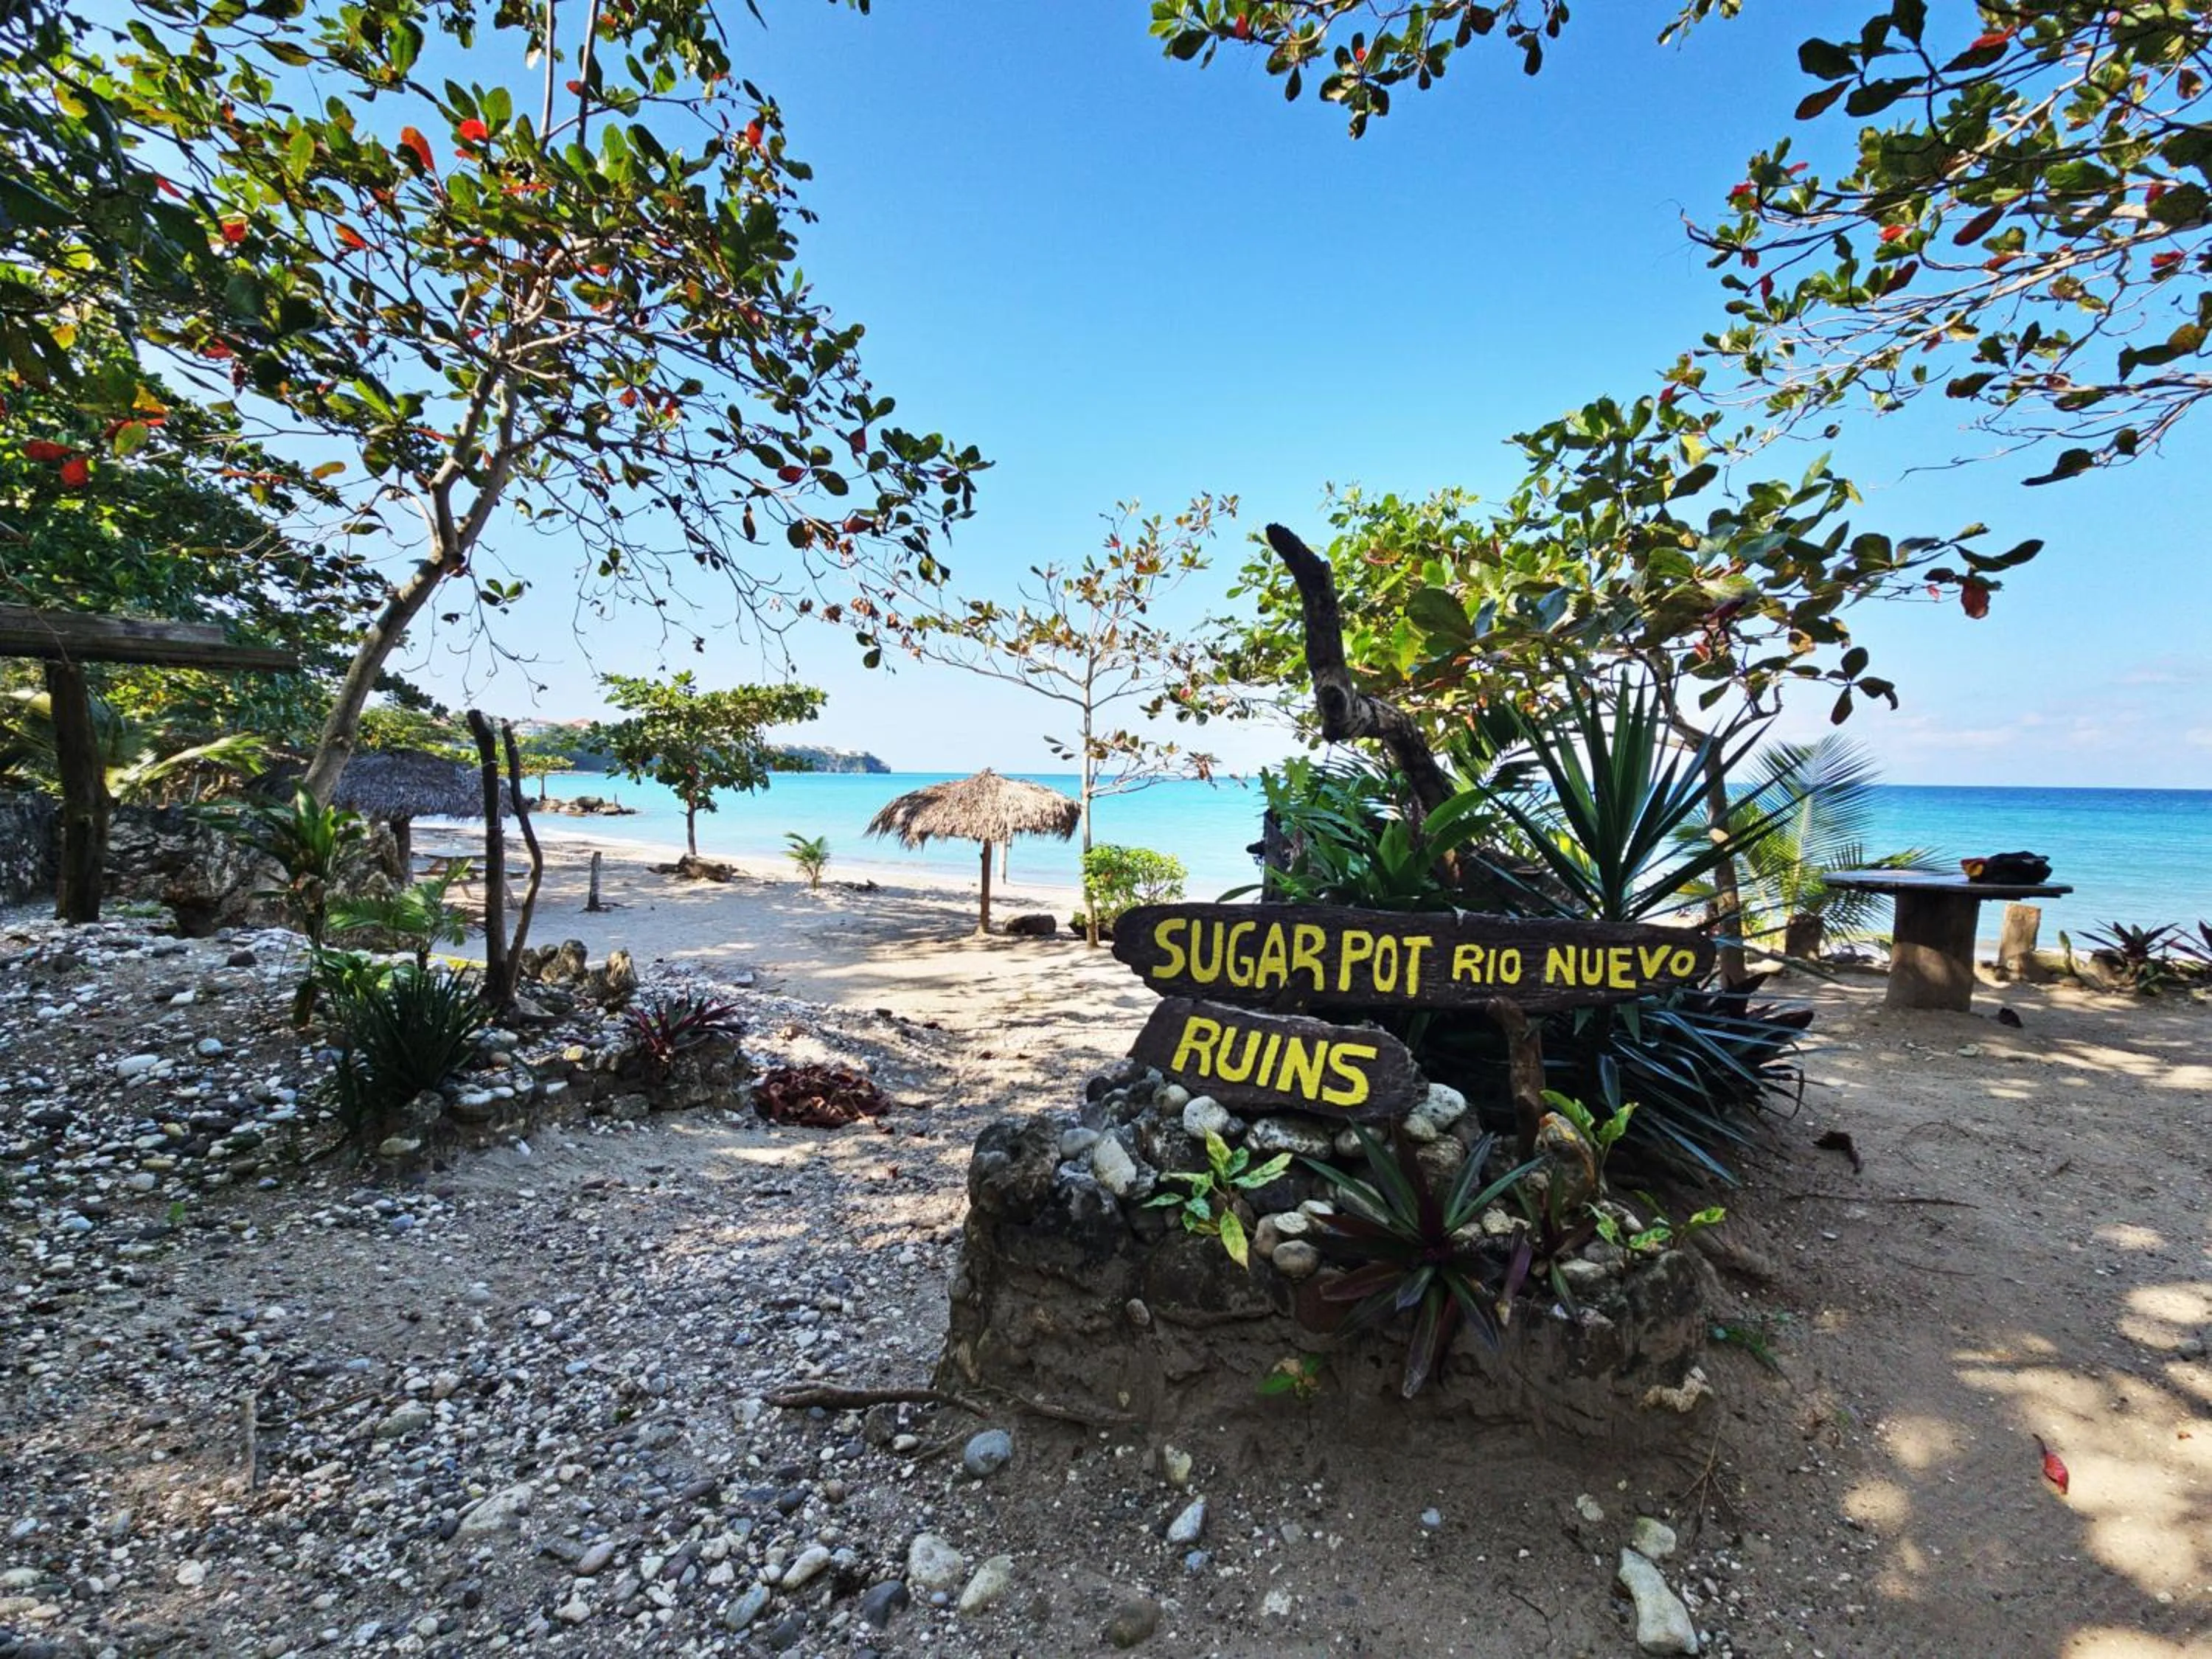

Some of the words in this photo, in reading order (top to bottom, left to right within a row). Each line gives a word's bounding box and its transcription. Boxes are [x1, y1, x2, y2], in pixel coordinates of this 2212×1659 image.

[1152, 919, 1326, 990] SUGAR
[1339, 930, 1433, 995] POT
[1452, 943, 1521, 984] RIO
[1545, 945, 1696, 990] NUEVO
[1172, 1015, 1377, 1107] RUINS
